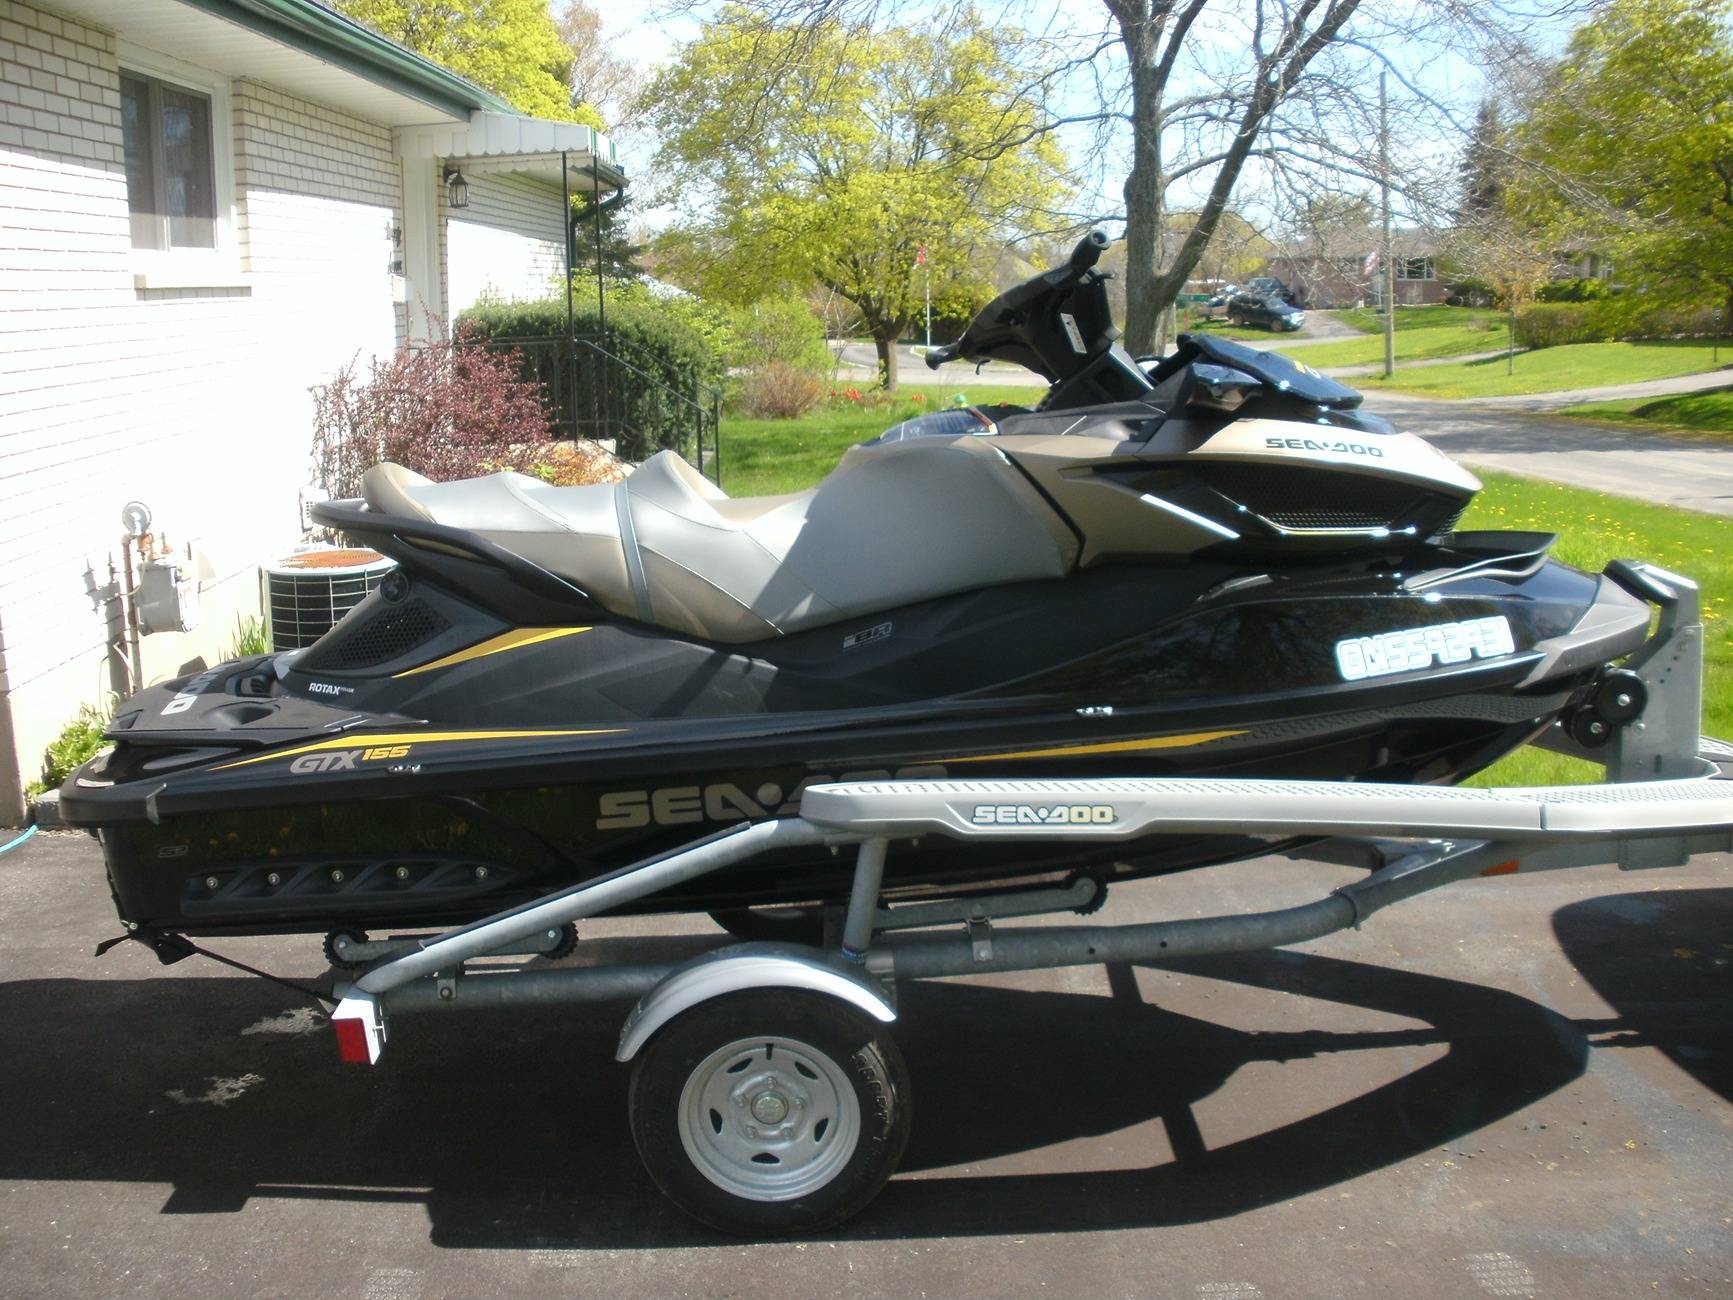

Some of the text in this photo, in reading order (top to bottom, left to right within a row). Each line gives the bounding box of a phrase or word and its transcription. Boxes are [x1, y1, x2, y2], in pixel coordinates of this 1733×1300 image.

[308, 682, 341, 696] ROTAX
[289, 744, 412, 774] GTX 155
